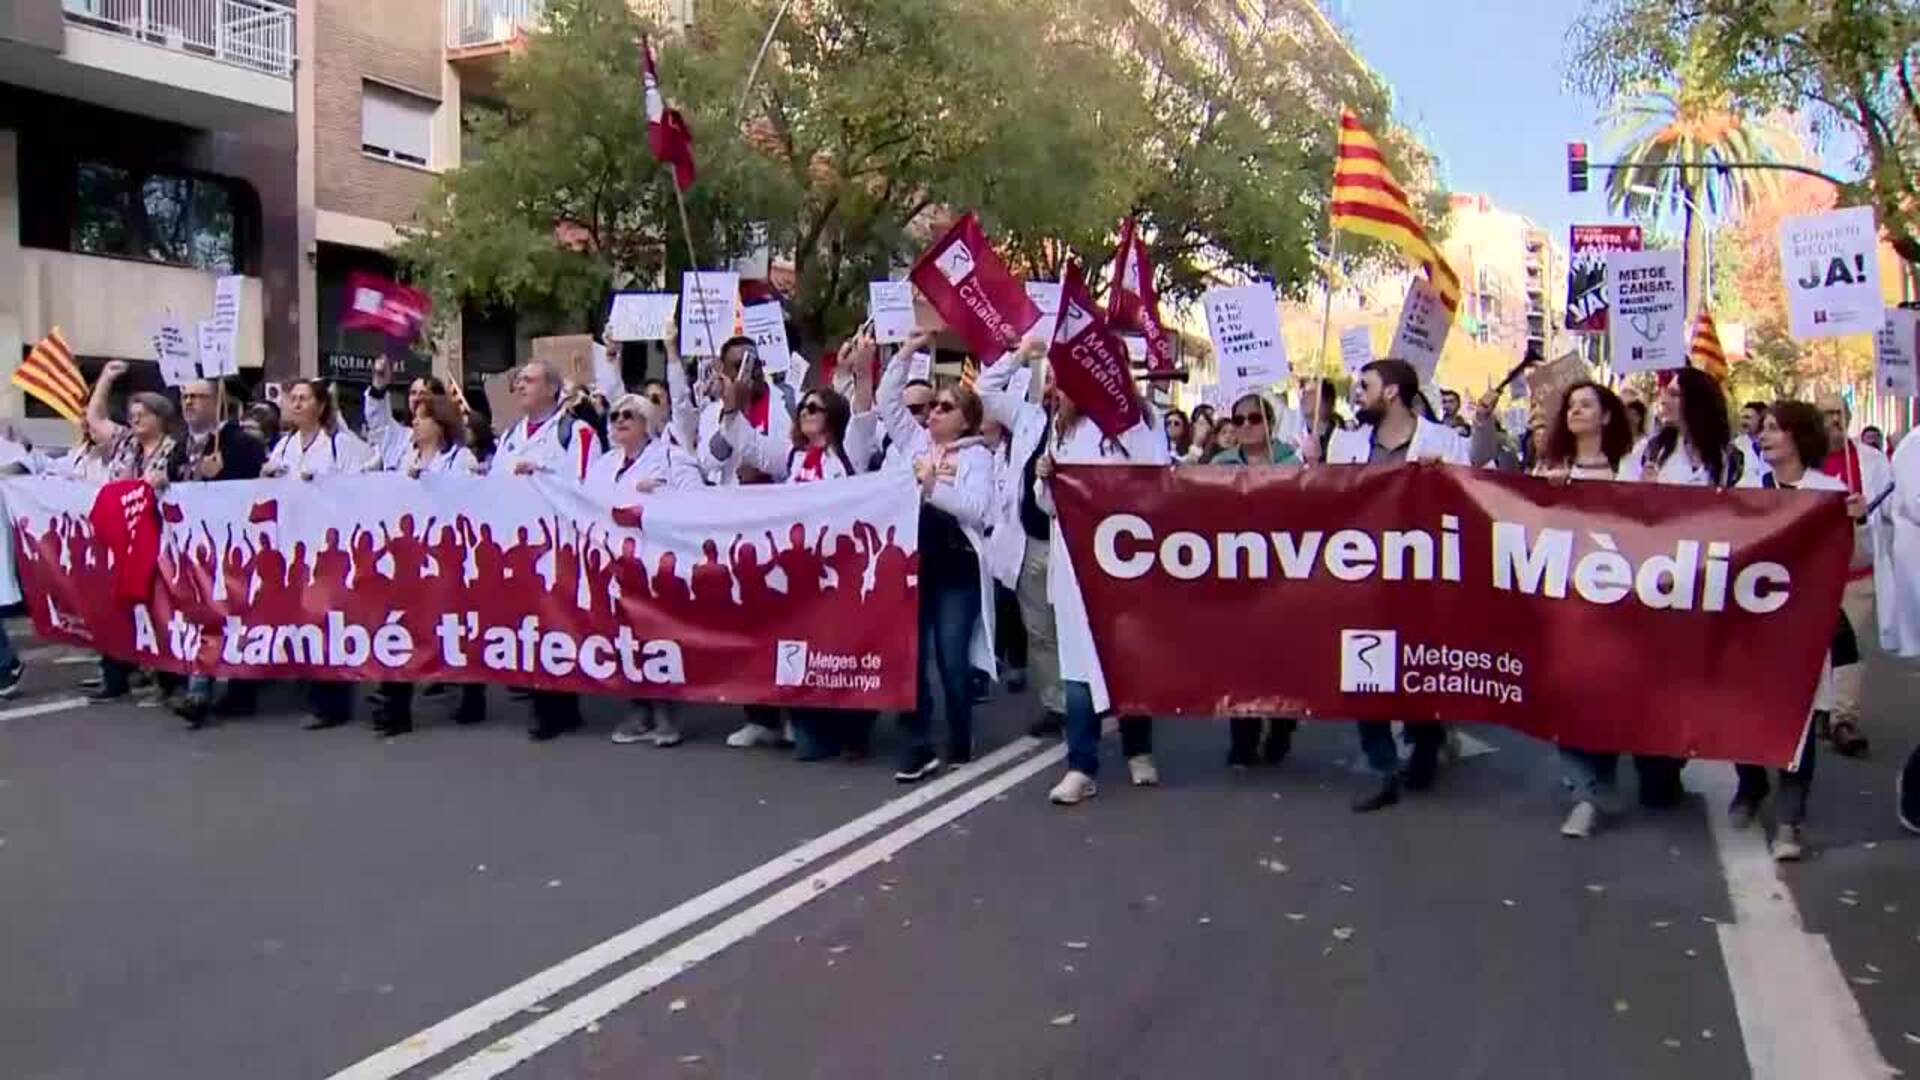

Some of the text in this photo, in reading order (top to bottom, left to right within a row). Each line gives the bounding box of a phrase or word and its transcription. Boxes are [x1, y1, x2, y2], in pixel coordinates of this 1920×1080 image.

[1619, 267, 1666, 281] METGE
[1798, 253, 1867, 289] JA!
[1094, 513, 1791, 614] Conveni Mèdic
[134, 603, 159, 656] A
[168, 610, 204, 661] tu
[222, 611, 414, 668] també
[436, 612, 687, 685] t'afecta
[1403, 644, 1523, 676] Metges de
[808, 651, 882, 672] Metges de
[805, 671, 881, 693] Catalunya
[1403, 672, 1523, 704] Catalunya
